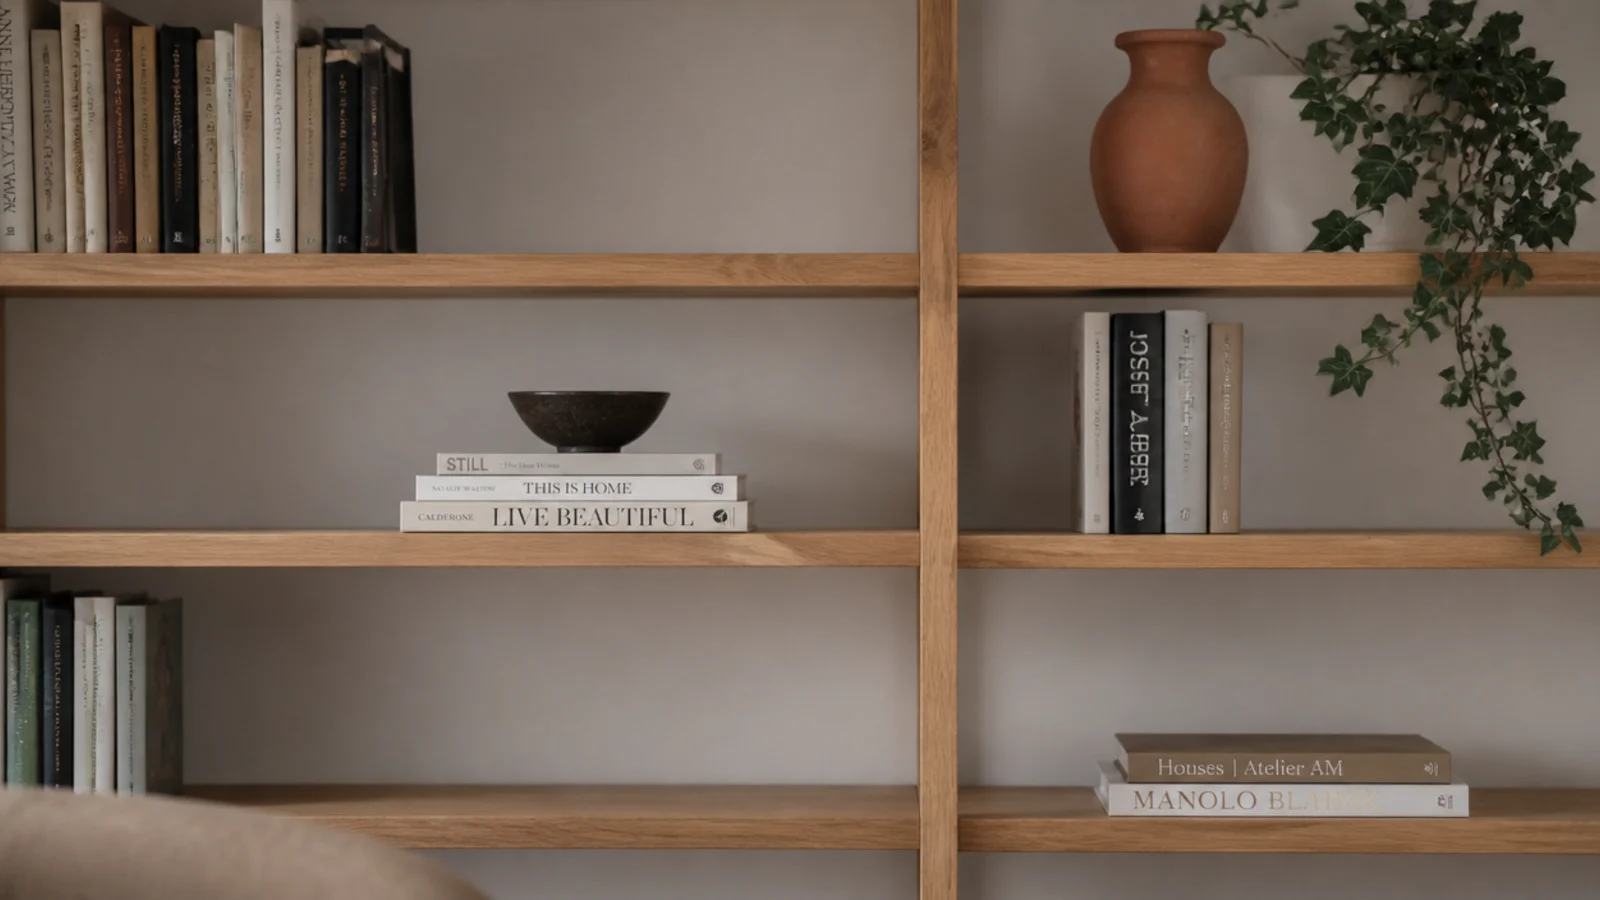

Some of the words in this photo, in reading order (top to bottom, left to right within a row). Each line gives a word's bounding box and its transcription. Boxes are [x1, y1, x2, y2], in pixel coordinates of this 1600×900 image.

[446, 457, 489, 472] STILL
[523, 482, 561, 494] THIS
[565, 482, 579, 494] IS
[583, 482, 632, 494] HOME
[417, 513, 475, 521] CALDERONE
[493, 507, 549, 527] LIVE
[557, 507, 694, 527] BEAUTIFUL
[1158, 758, 1225, 776] Houses
[1243, 758, 1305, 776] Atelier
[1309, 759, 1343, 777] AM
[1133, 790, 1257, 810] MANOLO
